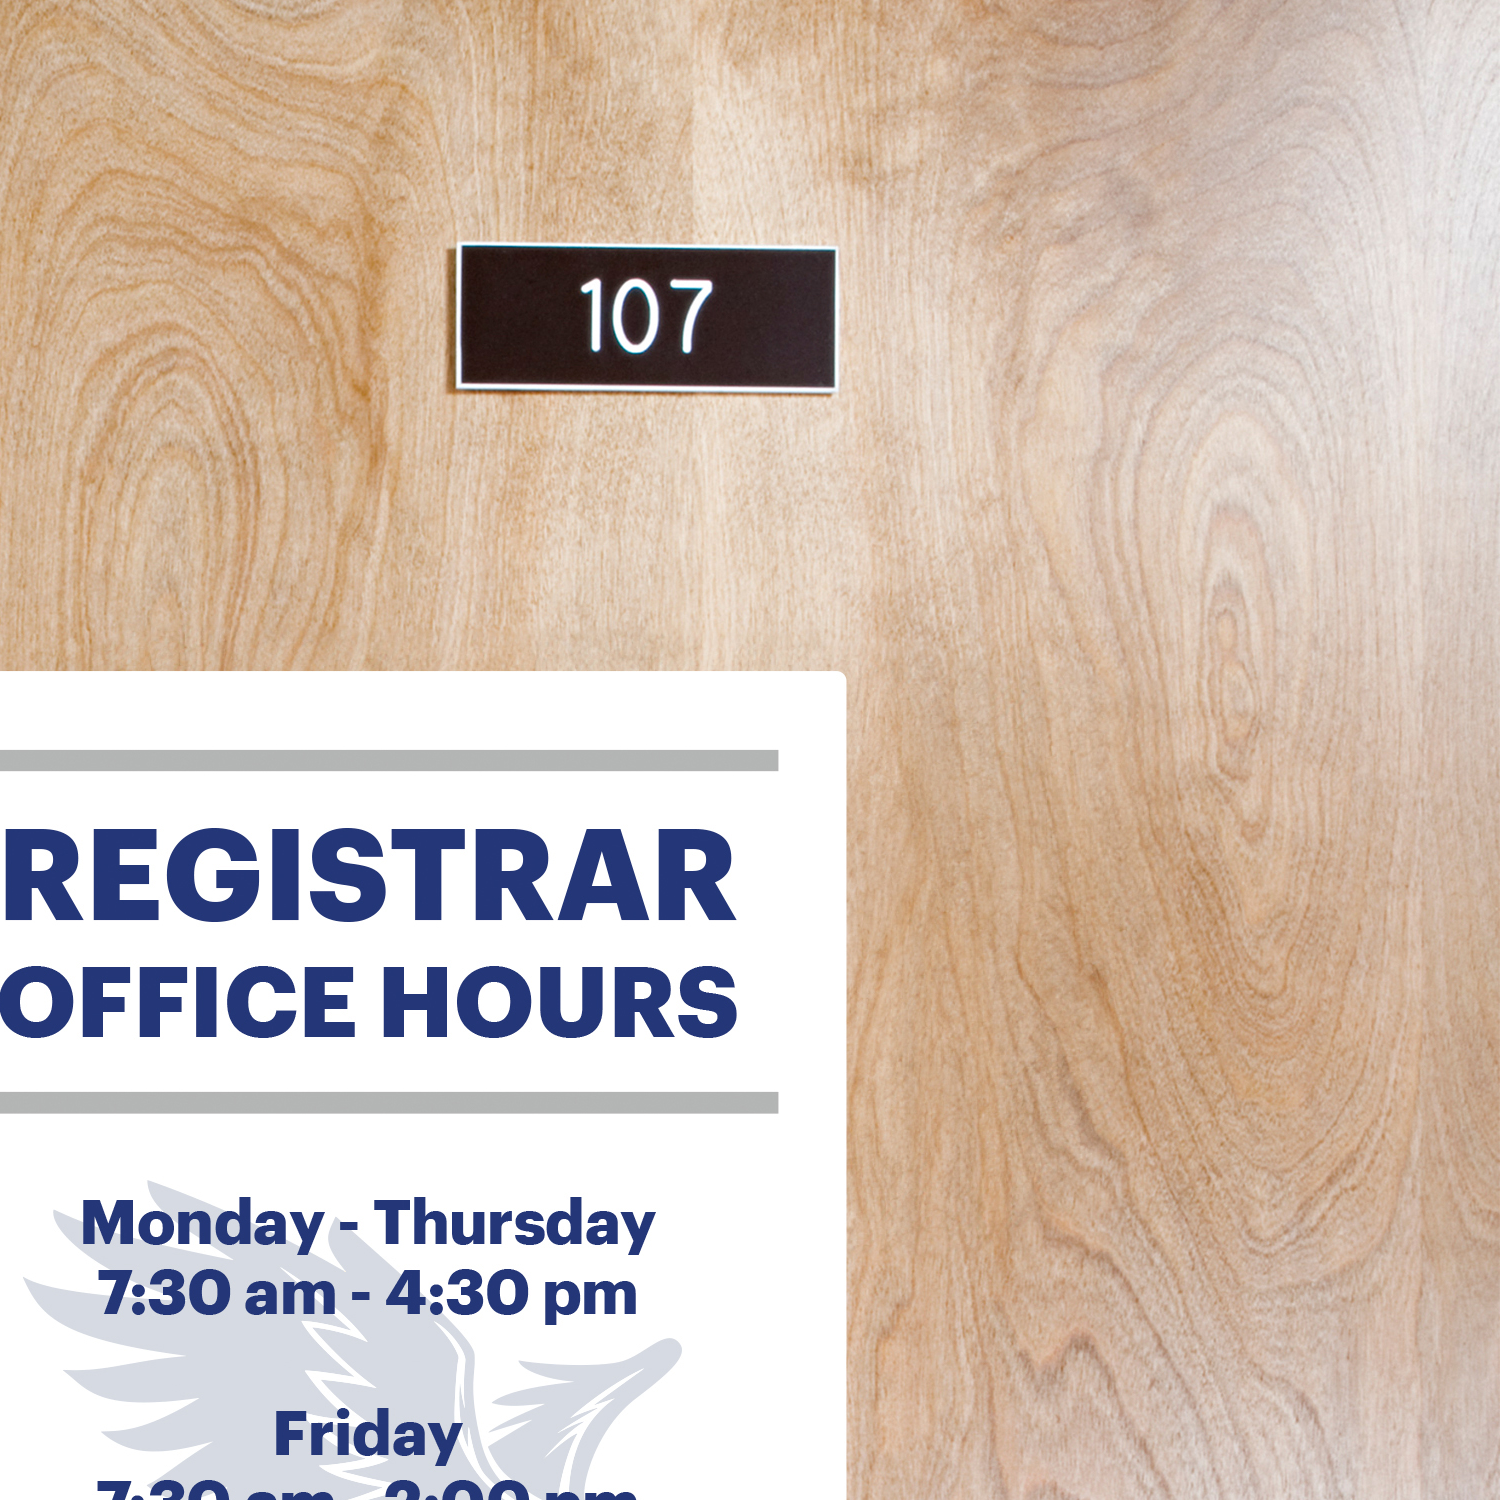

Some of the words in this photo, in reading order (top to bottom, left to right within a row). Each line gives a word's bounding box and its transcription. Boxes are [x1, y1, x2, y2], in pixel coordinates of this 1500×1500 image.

[580, 277, 713, 354] 107
[5, 827, 737, 923] REGISTRAR
[383, 965, 737, 1039] HOURS
[82, 1196, 326, 1256] Monday
[373, 1196, 657, 1256] Thursday
[98, 1268, 231, 1316] 7:30
[245, 1280, 336, 1316] am
[385, 1268, 529, 1316] 4:30
[545, 1280, 637, 1326] pm
[275, 1407, 464, 1467] Friday
